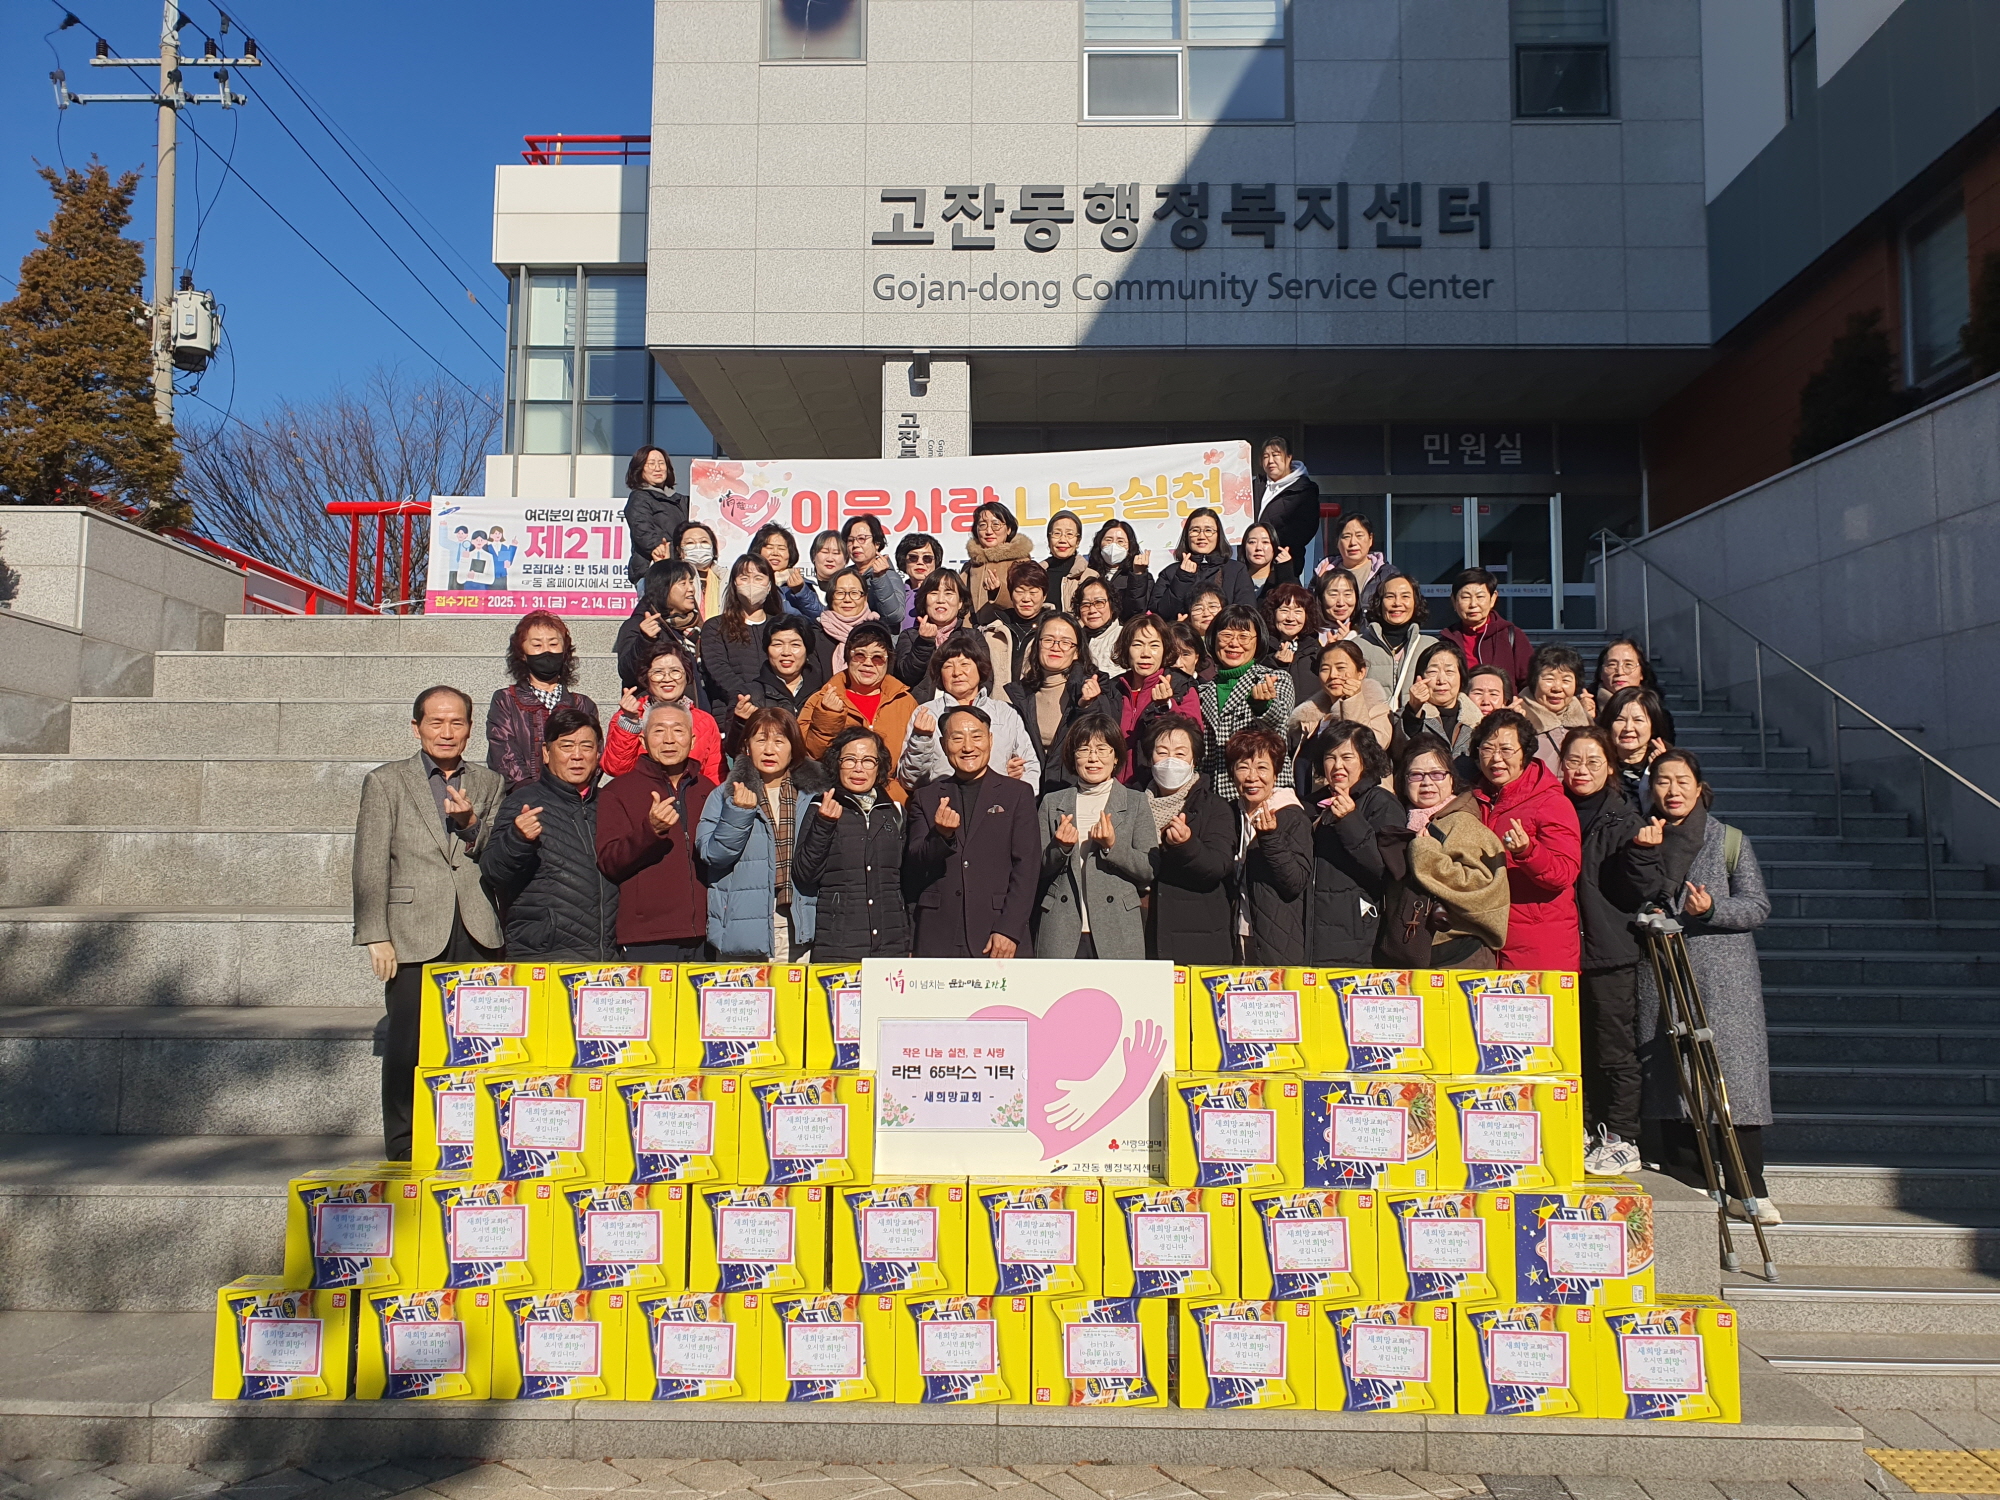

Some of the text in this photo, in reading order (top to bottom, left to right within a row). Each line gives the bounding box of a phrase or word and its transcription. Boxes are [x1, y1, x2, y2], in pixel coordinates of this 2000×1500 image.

[871, 182, 1491, 253] 고잔동행정복지센터
[873, 272, 1495, 308] Gojan-dong Community Service Center
[1423, 433, 1522, 465] 민원실
[790, 467, 1223, 535] 이웃사랑 나눔실천
[525, 509, 574, 523] 여러분의
[576, 509, 614, 523] 참여가
[524, 525, 623, 560] 제2기
[522, 563, 565, 576] 모집대상
[574, 564, 585, 575] 만
[587, 564, 609, 576] 15세
[532, 577, 543, 588] 동
[546, 577, 609, 589] 홈페이지에서
[435, 595, 478, 608] 접수기간
[487, 595, 517, 608] 2025.
[909, 979, 917, 990] 이
[920, 979, 945, 990] 넘치는
[470, 996, 510, 1004] 새희망교회에
[592, 997, 632, 1005] 새희망교회에
[715, 998, 756, 1006] 새희망교회에
[1240, 1001, 1281, 1009] 새희망교회에
[1363, 1005, 1404, 1013] 새희망교회에
[1493, 1004, 1534, 1012] 새희망교회에
[903, 1047, 1005, 1059] 작은 나눔 실천, 큰 사랑
[892, 1064, 1015, 1080] 라면 65박스 기탁
[924, 1091, 982, 1103] 새희망교회
[786, 1115, 828, 1123] 새희망교회에
[1214, 1119, 1256, 1128] 새희망교회에
[1346, 1116, 1388, 1126] 새희망교회에
[1478, 1120, 1520, 1130] 새희망교회에
[1071, 1162, 1161, 1174] 고잔동 행정복지센터
[466, 1216, 508, 1225] 새희망교회에
[733, 1218, 776, 1227] 새희망교회에
[1015, 1220, 1057, 1228] 새희망교회에
[1286, 1228, 1329, 1237] 새희망교회에
[1562, 1232, 1606, 1241] 새희망교회에
[540, 1332, 581, 1340] 새희망교회에
[801, 1333, 844, 1342] 새희망교회에
[1367, 1334, 1411, 1345] 새희망교회에
[1637, 1346, 1682, 1355] 새희망교회에
[1083, 1357, 1126, 1366] 새희망교회에
